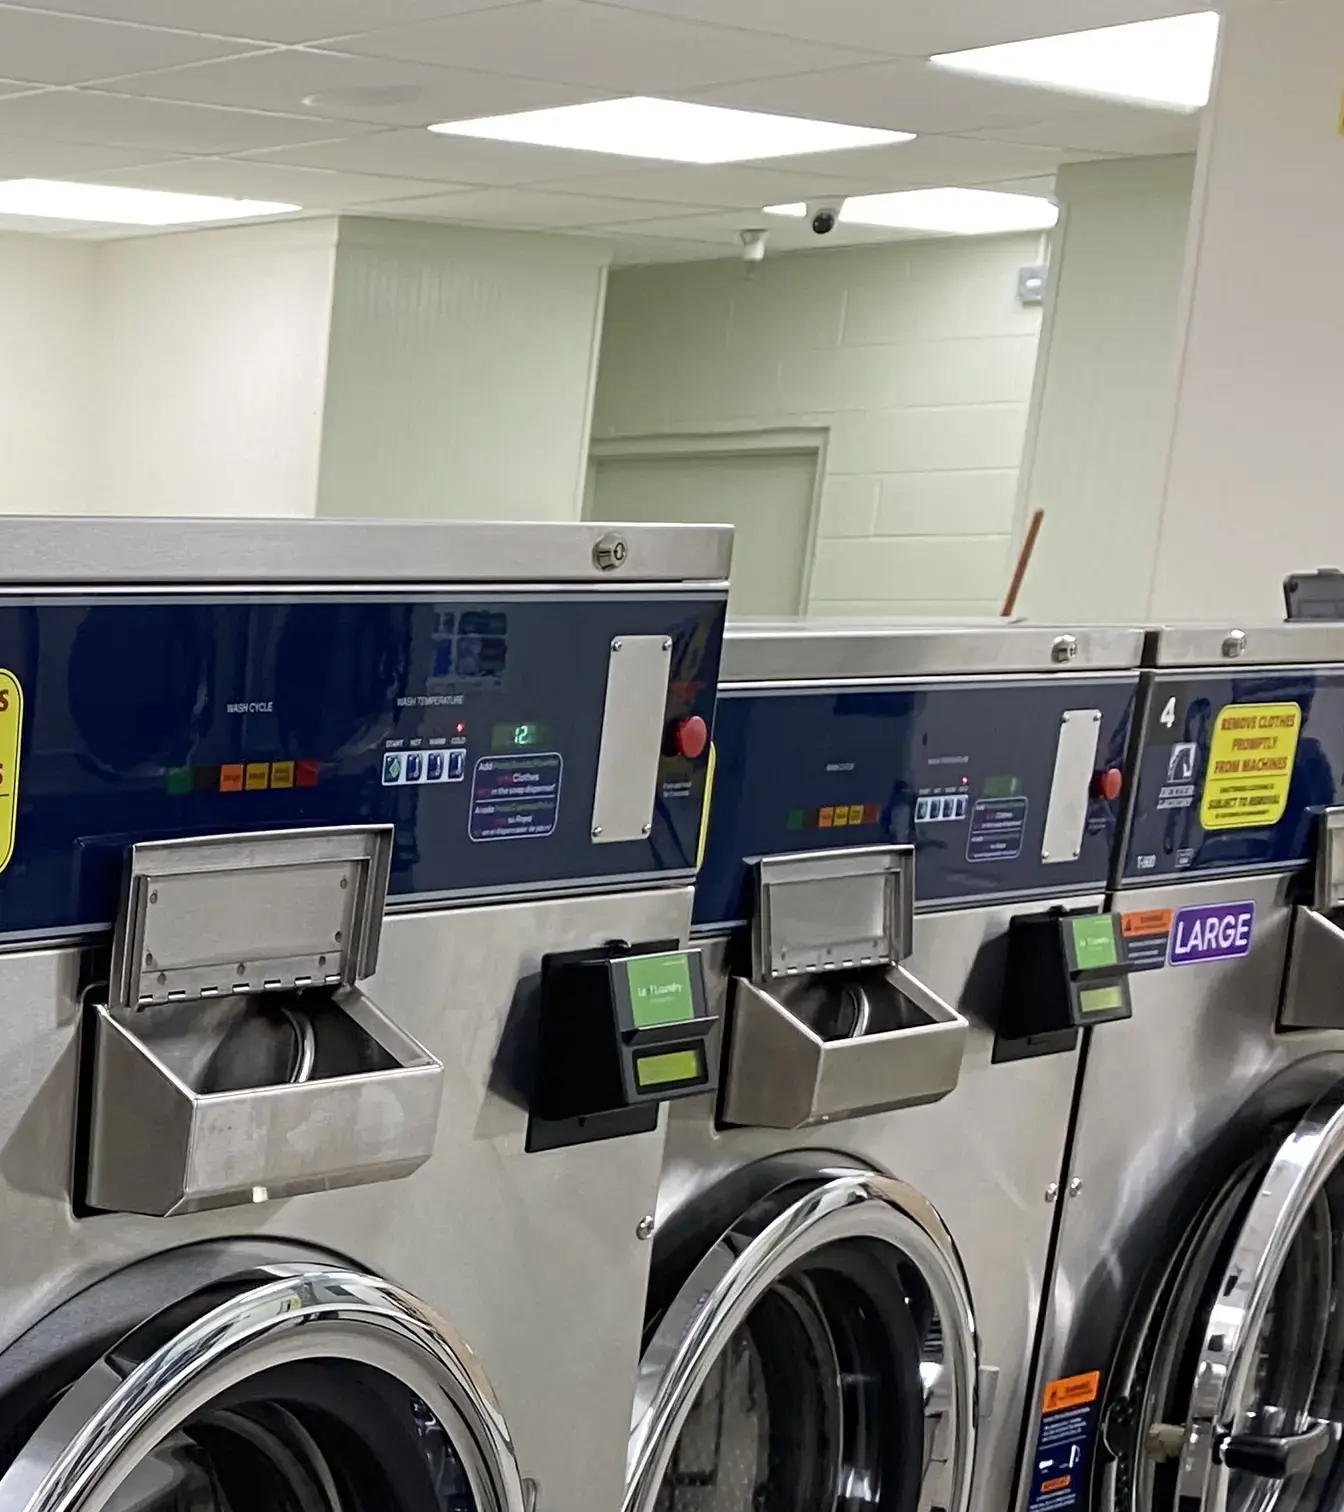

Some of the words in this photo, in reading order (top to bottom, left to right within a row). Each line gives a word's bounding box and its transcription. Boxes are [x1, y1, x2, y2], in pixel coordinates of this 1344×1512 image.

[1160, 697, 1176, 728] 4
[1222, 718, 1256, 730] REMOVE
[1259, 714, 1294, 729] CLOTHES
[1215, 760, 1240, 774] FROM
[1242, 756, 1288, 772] MACHINES
[1174, 913, 1251, 954] LARGE
